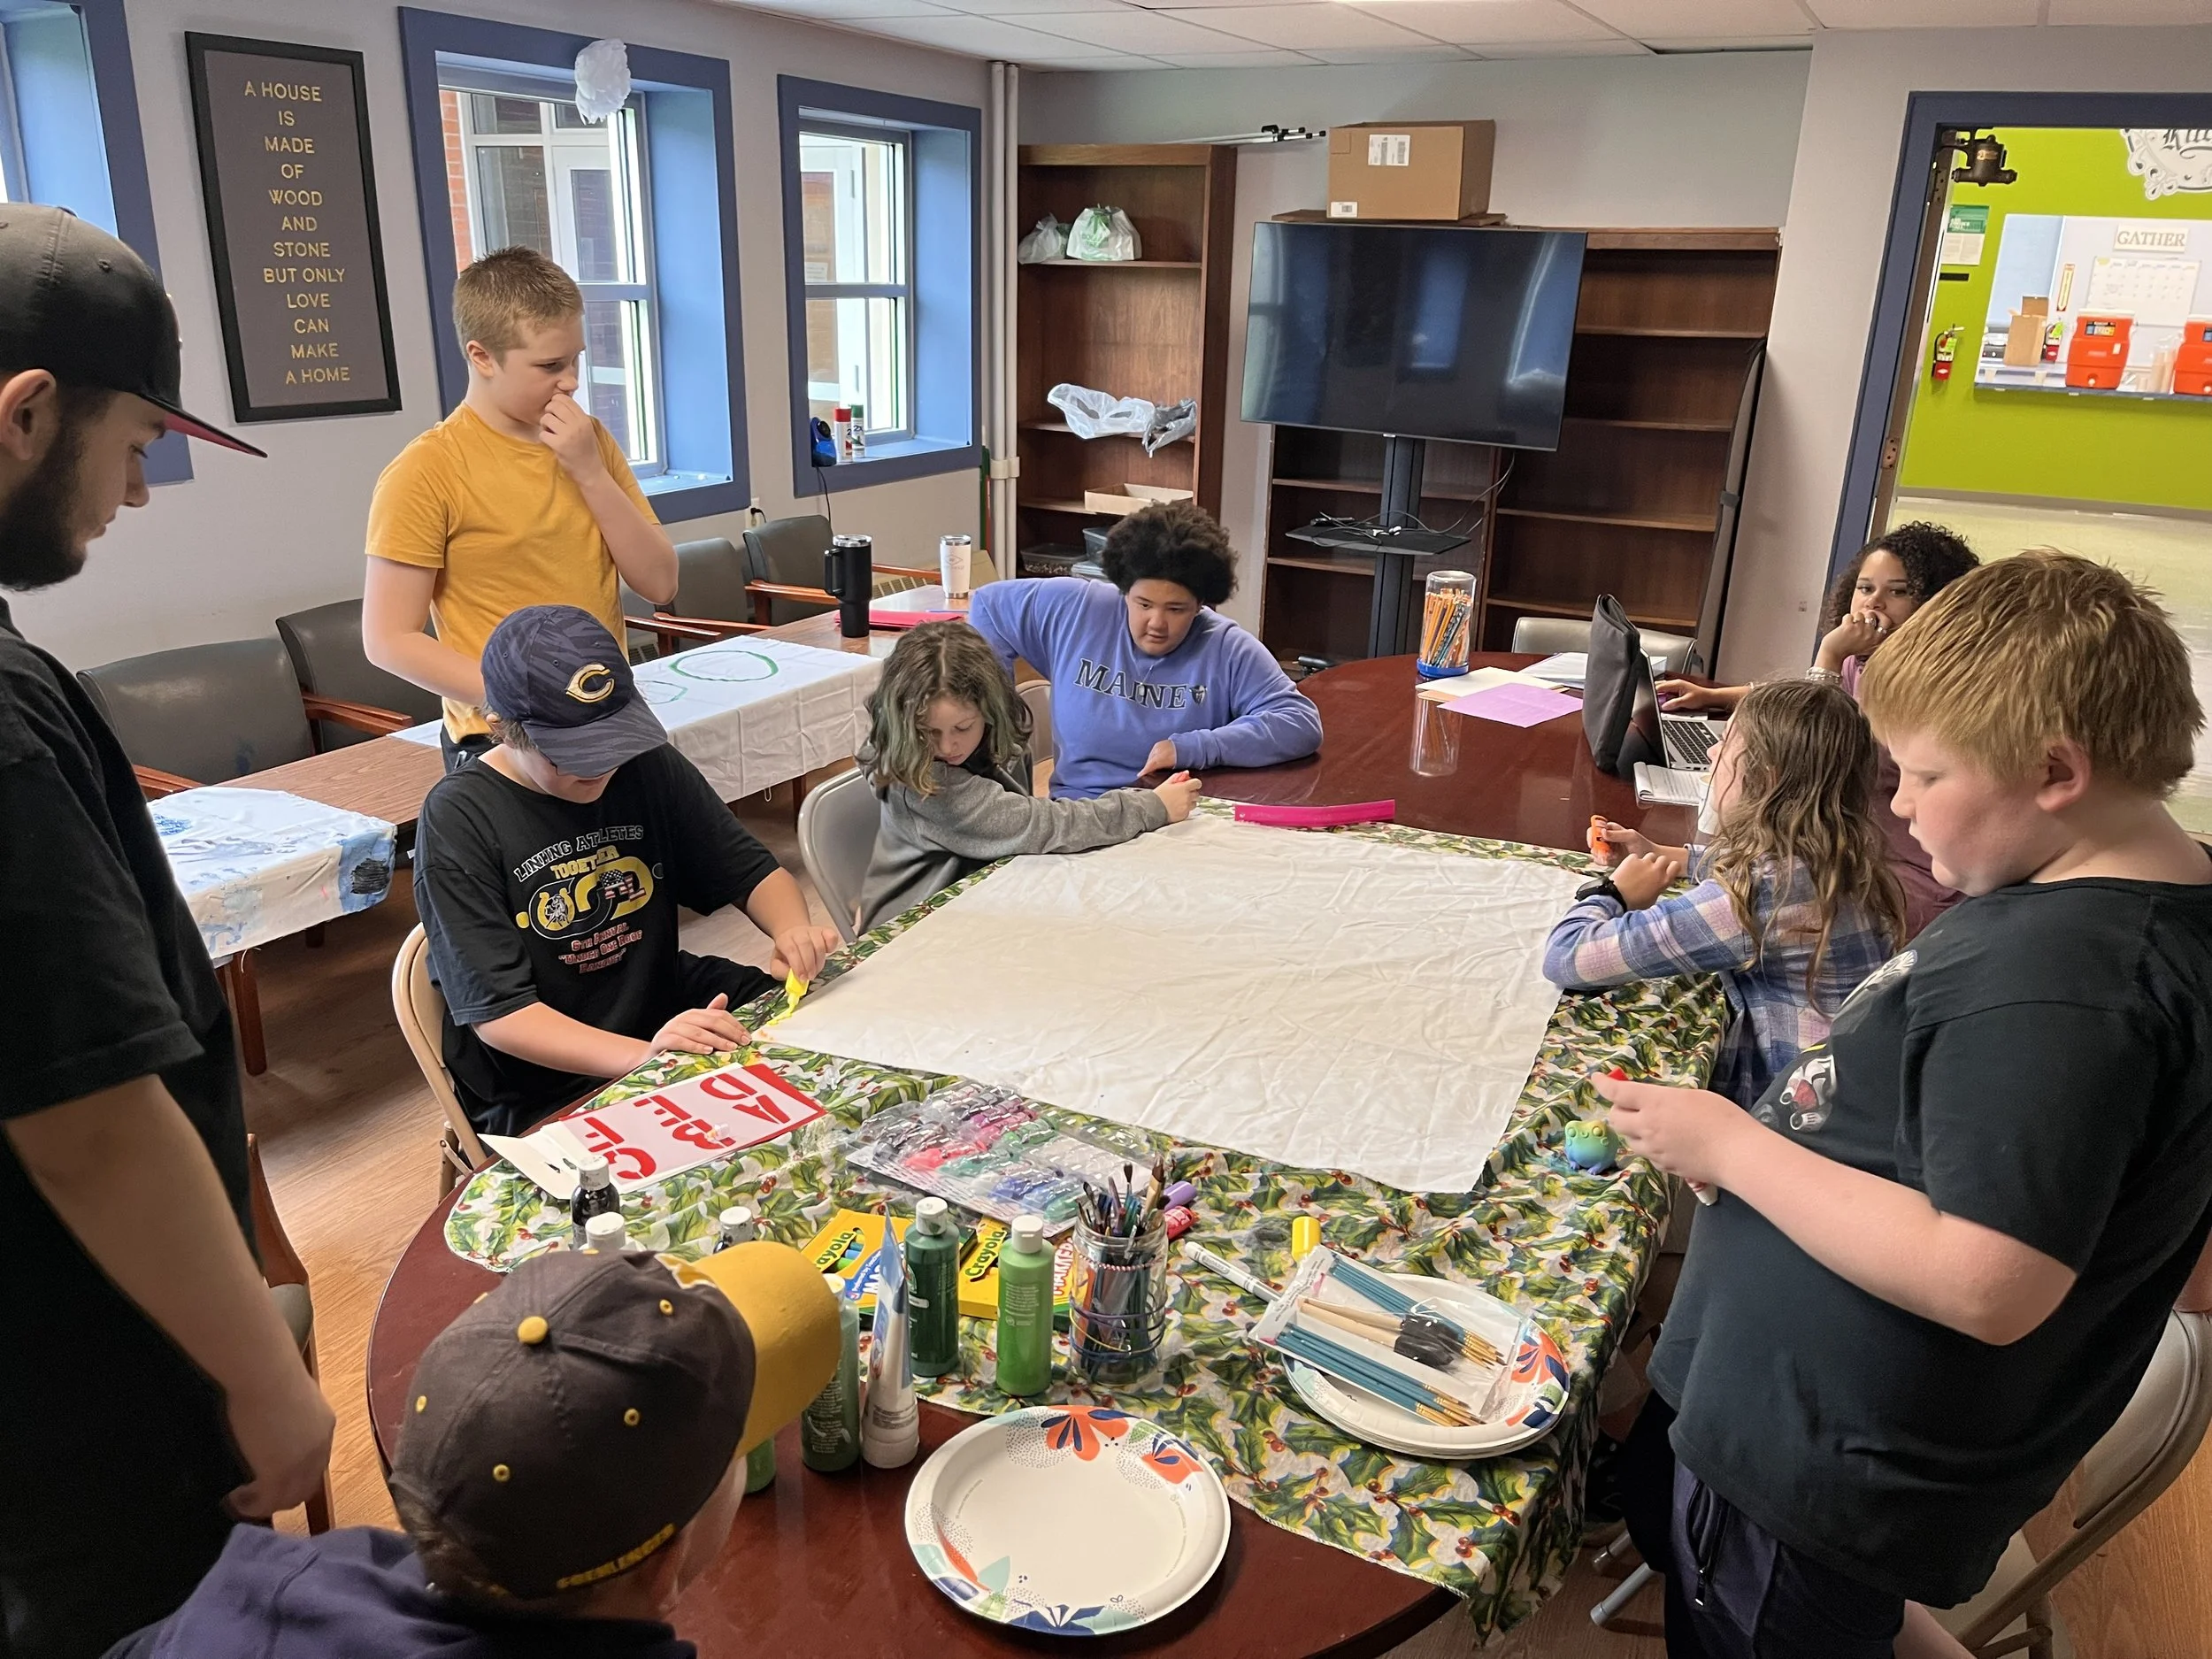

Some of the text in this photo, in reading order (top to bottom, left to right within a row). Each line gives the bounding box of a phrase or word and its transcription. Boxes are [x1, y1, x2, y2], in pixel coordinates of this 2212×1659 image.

[244, 81, 322, 102] A HOUSE
[278, 110, 295, 127] IS
[265, 135, 315, 154] MADE
[280, 163, 304, 179] OF
[268, 188, 323, 206] WOOD
[281, 216, 318, 232] AND
[2116, 230, 2185, 247] GATHER
[273, 242, 331, 257] STONE
[263, 267, 345, 283] BUT ONLY
[286, 293, 331, 309] LOVE
[294, 318, 329, 334] CAN
[290, 342, 339, 359] MAKE
[285, 367, 350, 384] A HOME
[565, 662, 615, 704] C
[1073, 658, 1189, 709] MAINE
[576, 826, 644, 852] ATLETES
[550, 844, 620, 879] TOGETER
[816, 1232, 855, 1266] ayola
[964, 1230, 1006, 1278] Crayola
